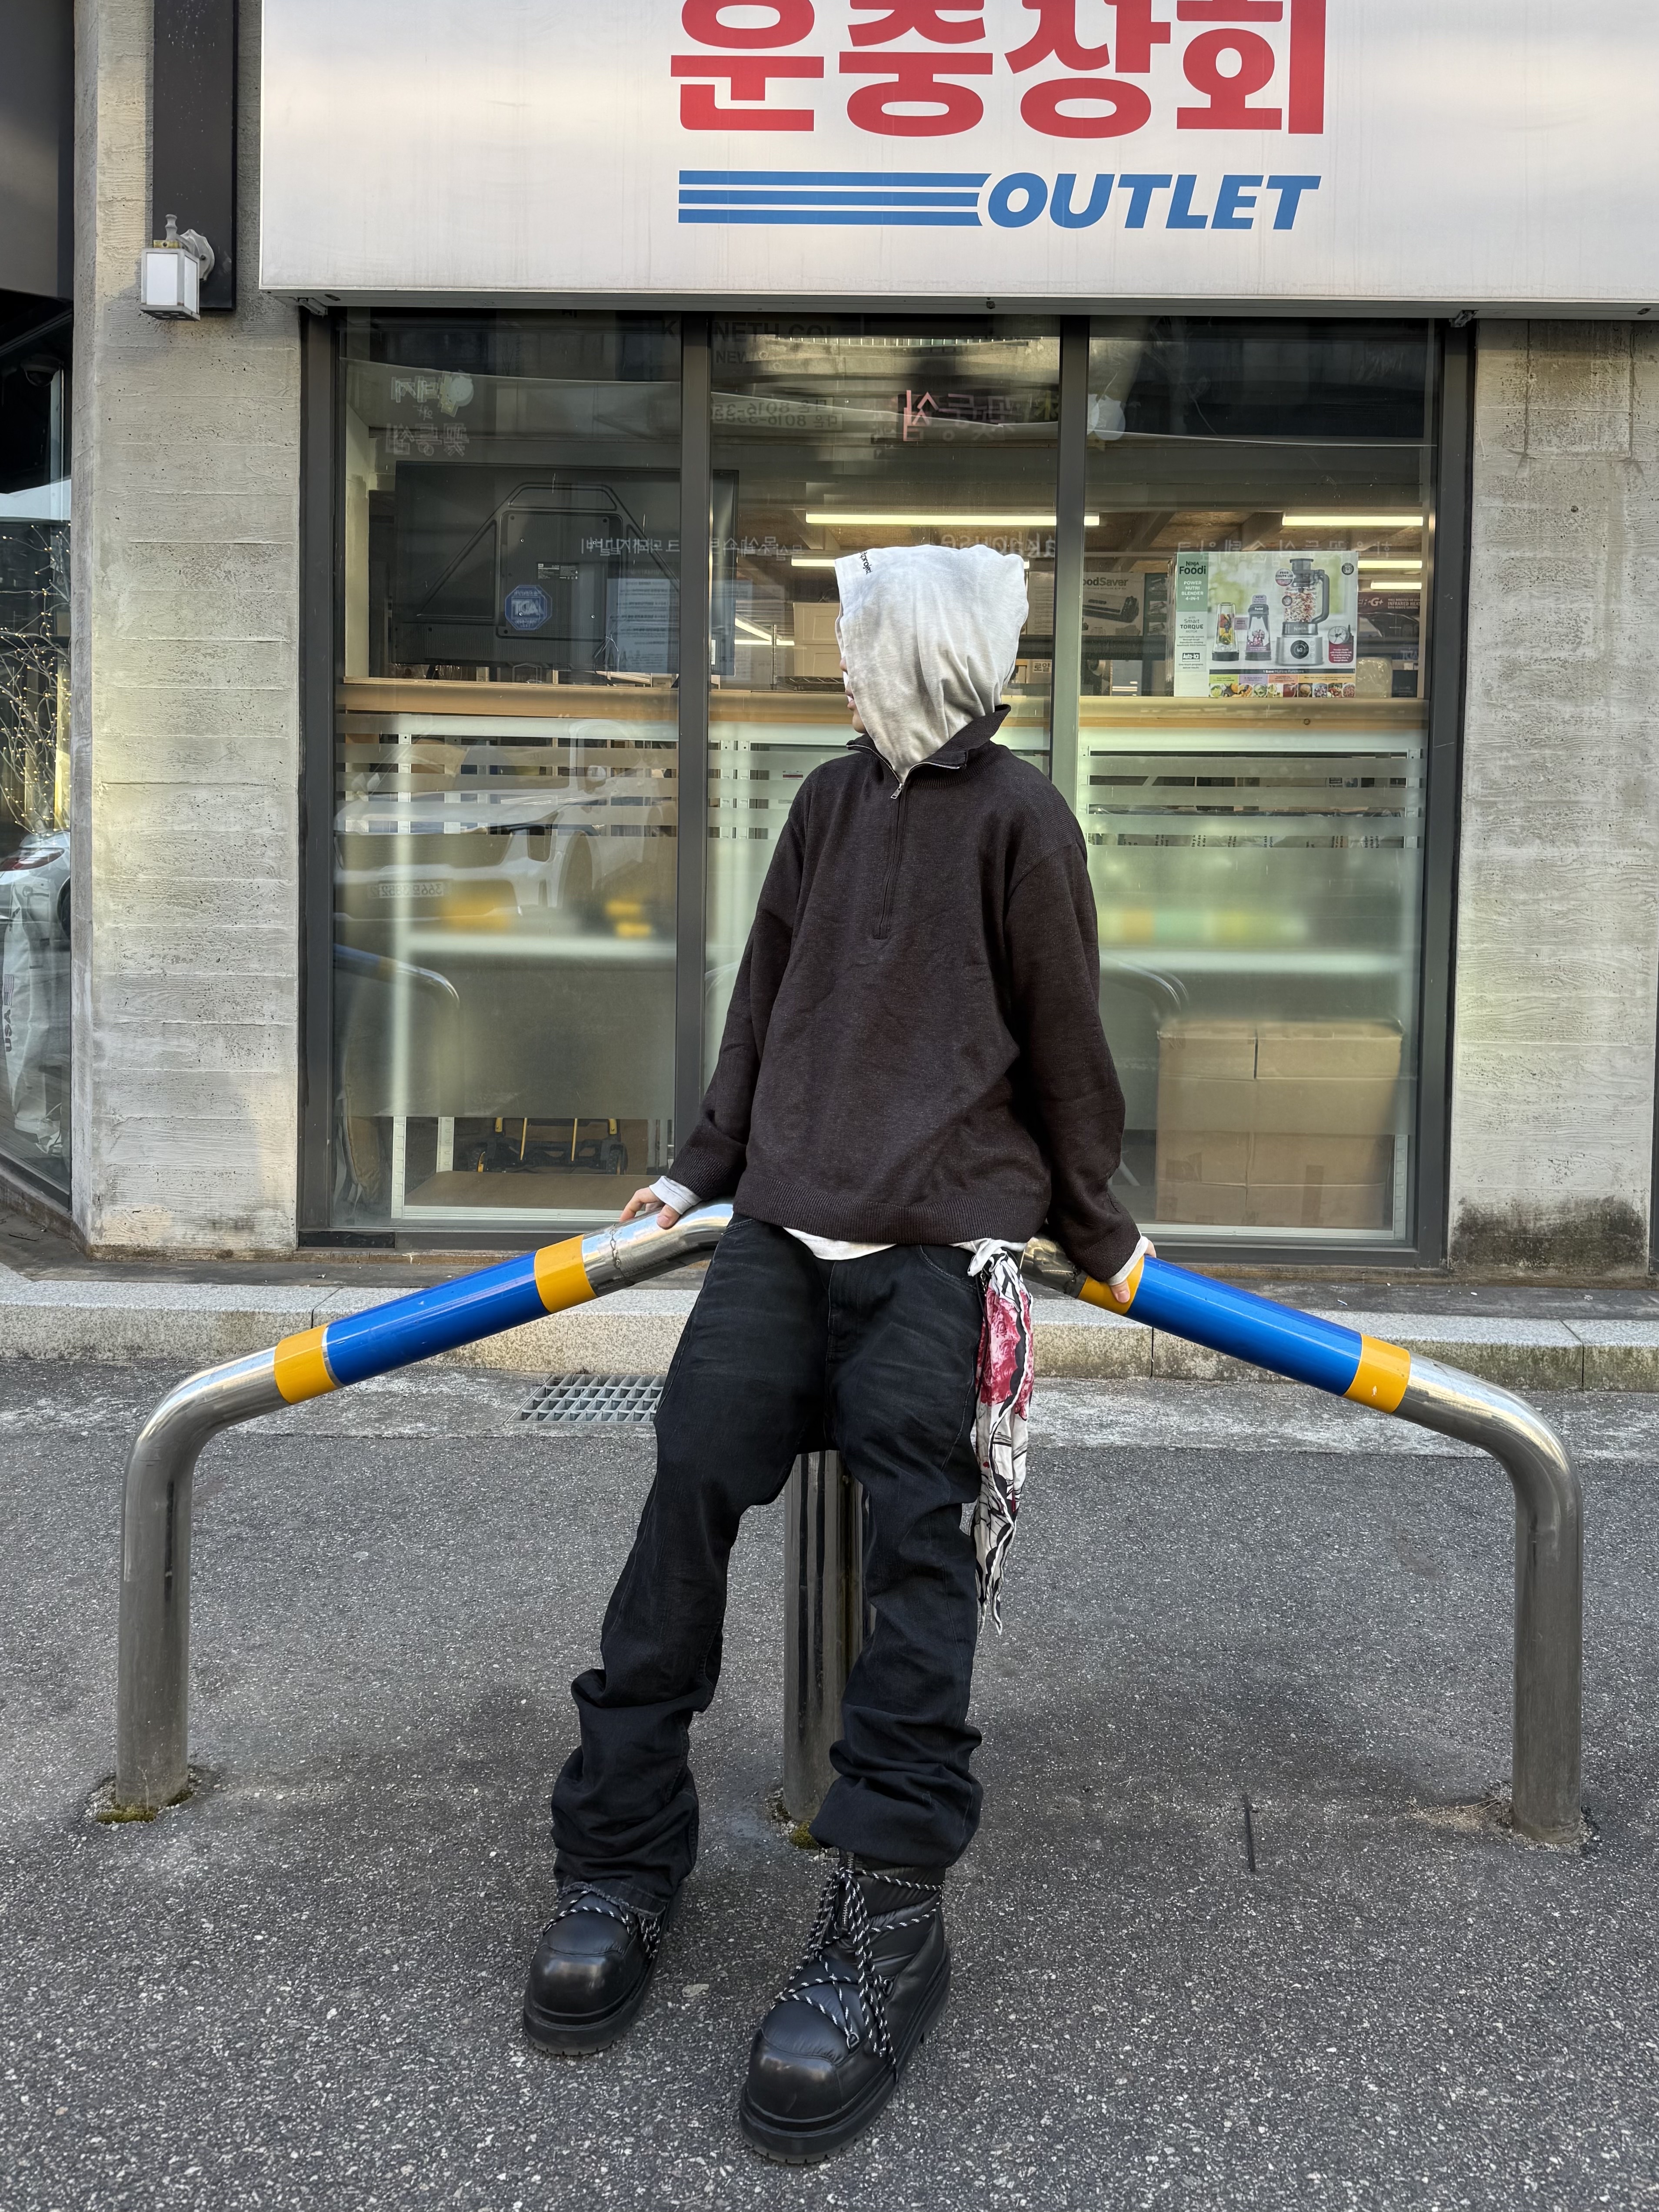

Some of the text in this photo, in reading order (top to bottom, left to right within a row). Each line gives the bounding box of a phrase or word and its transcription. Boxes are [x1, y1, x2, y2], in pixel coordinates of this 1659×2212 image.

[987, 171, 1321, 230] OUTLET
[1179, 565, 1206, 574] Foodi
[3, 1009, 12, 1052] USA
